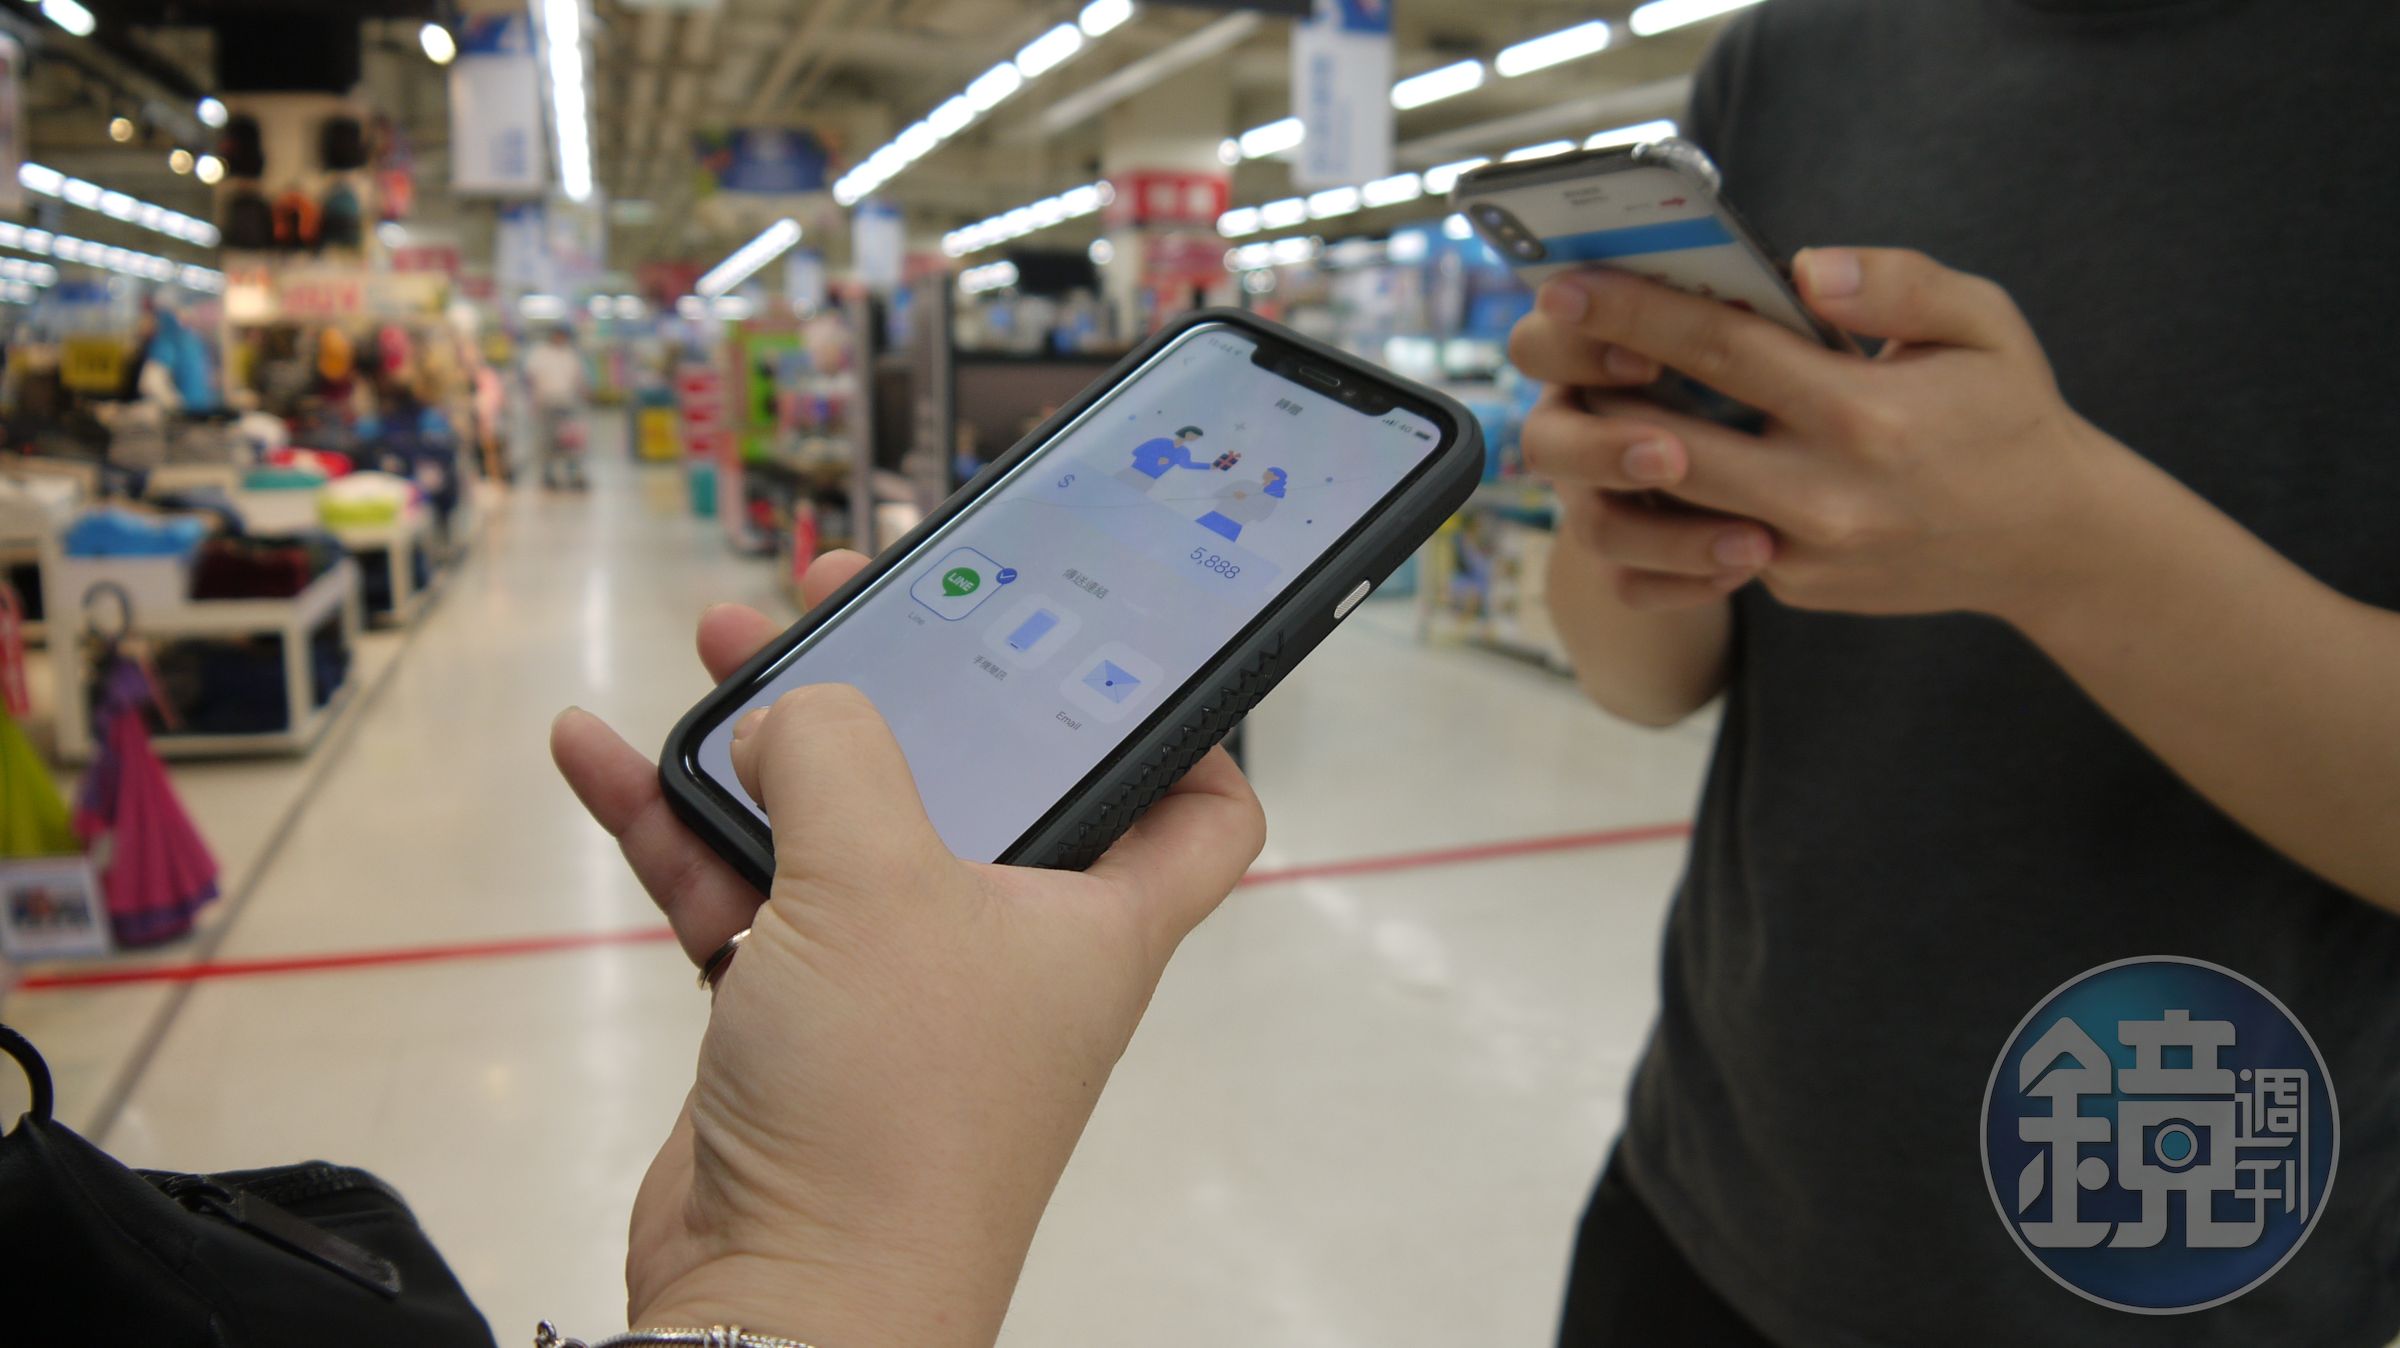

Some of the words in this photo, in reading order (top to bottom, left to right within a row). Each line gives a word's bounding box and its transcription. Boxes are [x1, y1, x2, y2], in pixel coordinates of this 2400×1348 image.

[1057, 473, 1075, 489] $
[1190, 546, 1240, 579] 5,888
[946, 572, 975, 592] LINE
[1062, 568, 1109, 600] 傳送連結
[972, 653, 1008, 682] 手機簡訊
[1055, 709, 1083, 731] Email
